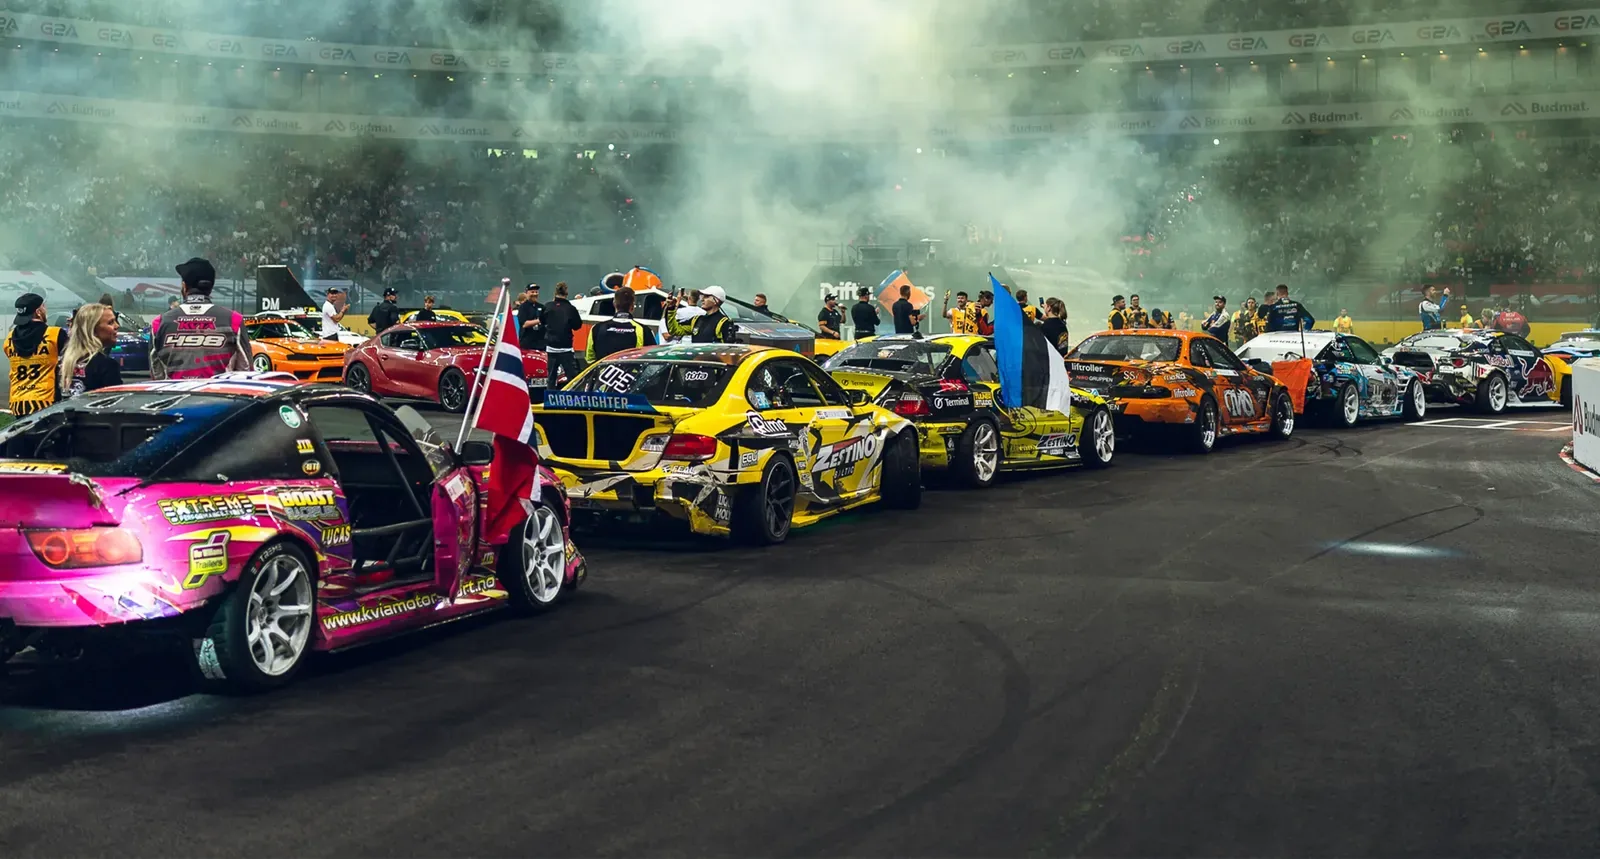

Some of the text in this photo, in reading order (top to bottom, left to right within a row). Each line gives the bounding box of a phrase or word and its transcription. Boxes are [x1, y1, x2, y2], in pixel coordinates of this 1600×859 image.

[40, 21, 79, 40] G2A
[1484, 20, 1532, 36] G2A
[1554, 15, 1600, 32] G2A
[1288, 33, 1331, 48] G2A
[1352, 29, 1396, 44] G2A
[1416, 25, 1462, 41] G2A
[261, 42, 299, 58] G2A
[1166, 39, 1207, 55] G2A
[1226, 37, 1268, 51] G2A
[318, 46, 357, 62] G2A
[374, 51, 412, 66] G2A
[430, 53, 469, 67] G2A
[1047, 46, 1087, 61] G2A
[1531, 99, 1590, 114] Budmat.
[1308, 110, 1364, 125] Budmat.
[261, 297, 281, 311] DM
[165, 333, 227, 348] 498
[17, 364, 41, 382] 83
[548, 394, 629, 409] CIRBAFIGHTER
[944, 397, 970, 407] Terminal
[1037, 433, 1077, 449] ZESTINO
[812, 433, 877, 473] ZESTINO
[278, 490, 335, 507] BOOST
[160, 495, 253, 523] EXTREME
[322, 526, 351, 545] LUCAS
[195, 559, 223, 570] Trailers
